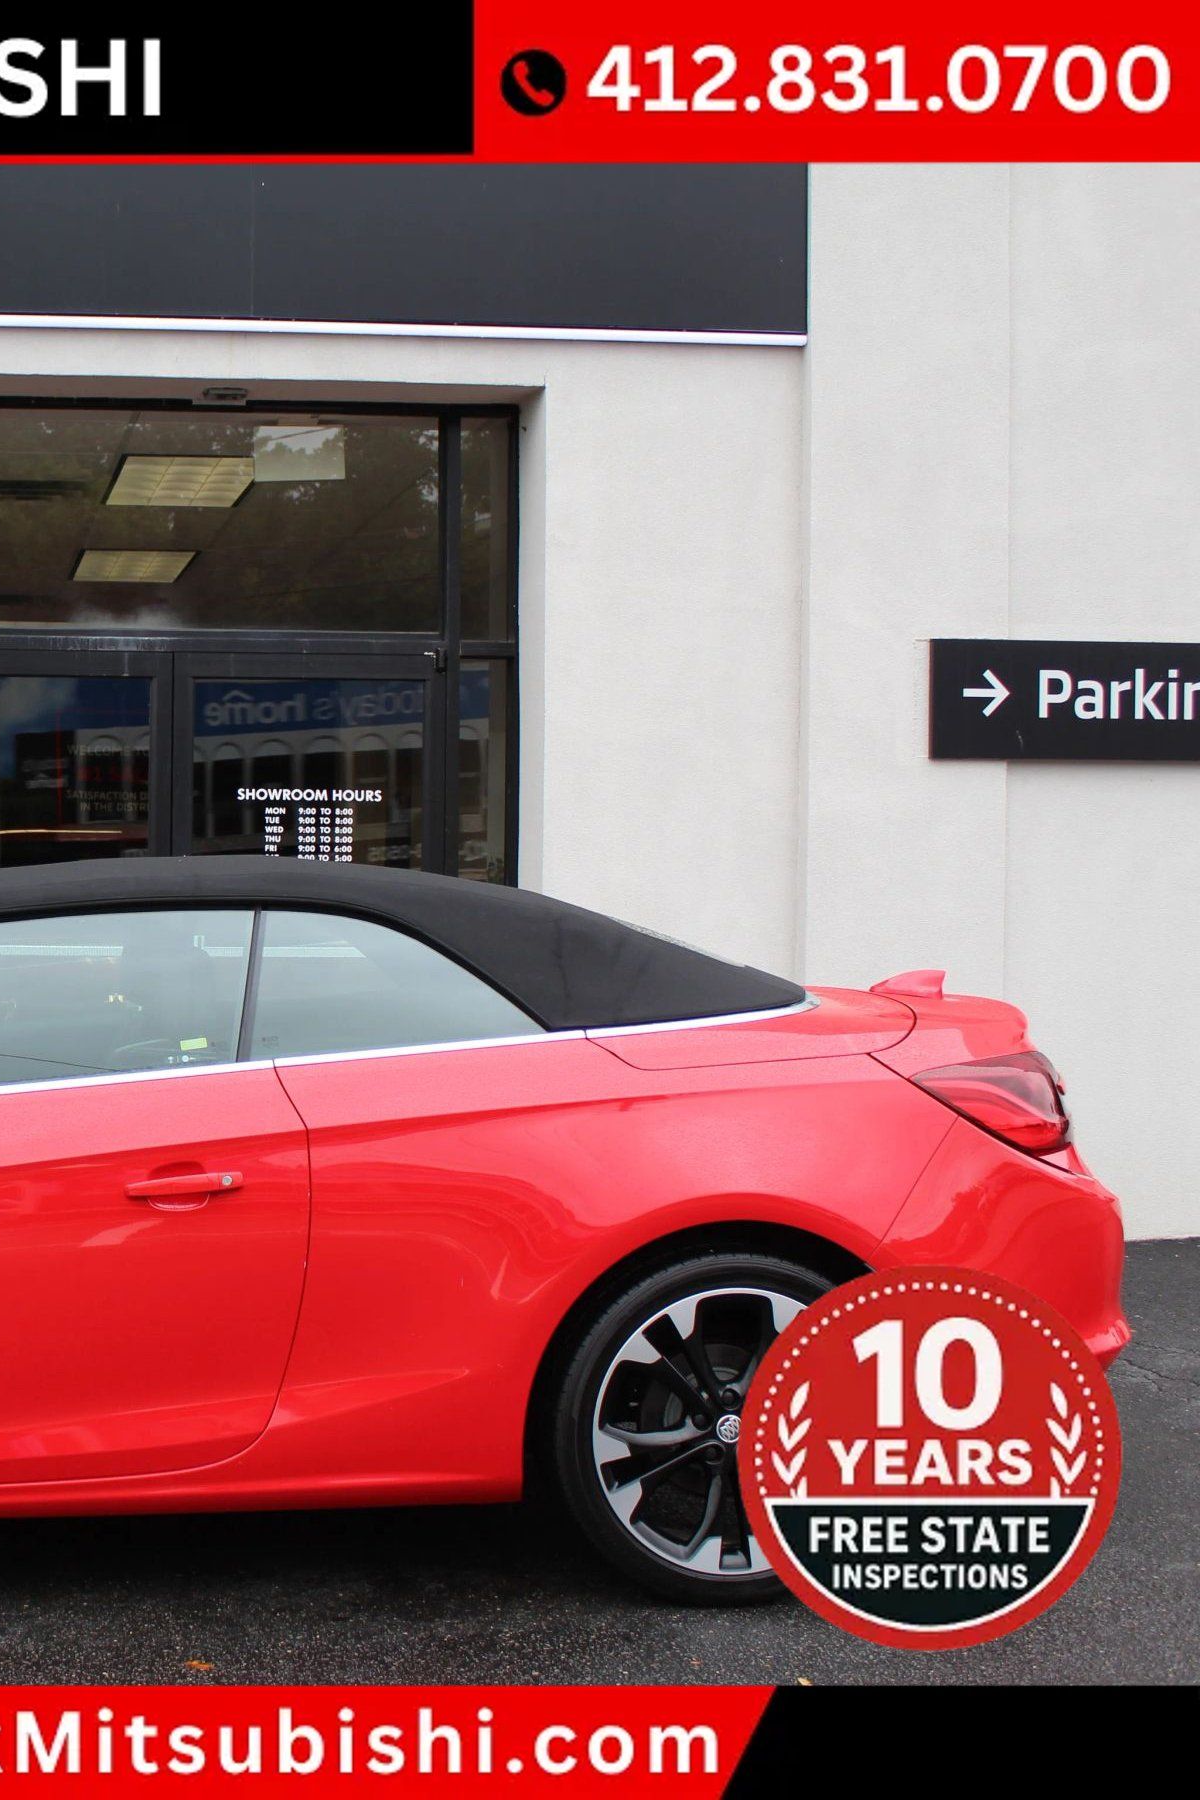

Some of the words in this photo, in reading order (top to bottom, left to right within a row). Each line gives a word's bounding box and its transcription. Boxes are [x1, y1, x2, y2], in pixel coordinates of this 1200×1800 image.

[237, 788, 328, 801] SHOWROOM
[332, 789, 382, 802] HOURS
[94, 802, 113, 812] THE
[265, 807, 286, 815] MON
[298, 808, 316, 816] 9:00
[320, 808, 332, 816] TO
[335, 808, 353, 816] 8:00
[265, 816, 280, 824] TUE
[298, 817, 316, 825] 9:00
[319, 817, 331, 825] TO
[335, 817, 353, 825] 8:00
[265, 825, 284, 833] WED
[298, 826, 316, 834] 9:00
[319, 826, 331, 834] TO
[334, 826, 353, 834] 8:00
[265, 835, 281, 843] THU
[298, 835, 316, 843] 9:00
[319, 836, 331, 844] TO
[334, 836, 353, 844] 8:00
[264, 844, 277, 852] FRI
[298, 844, 316, 852] 9:00
[319, 845, 331, 853] TO
[334, 845, 352, 853] 6:00
[318, 854, 330, 862] TO
